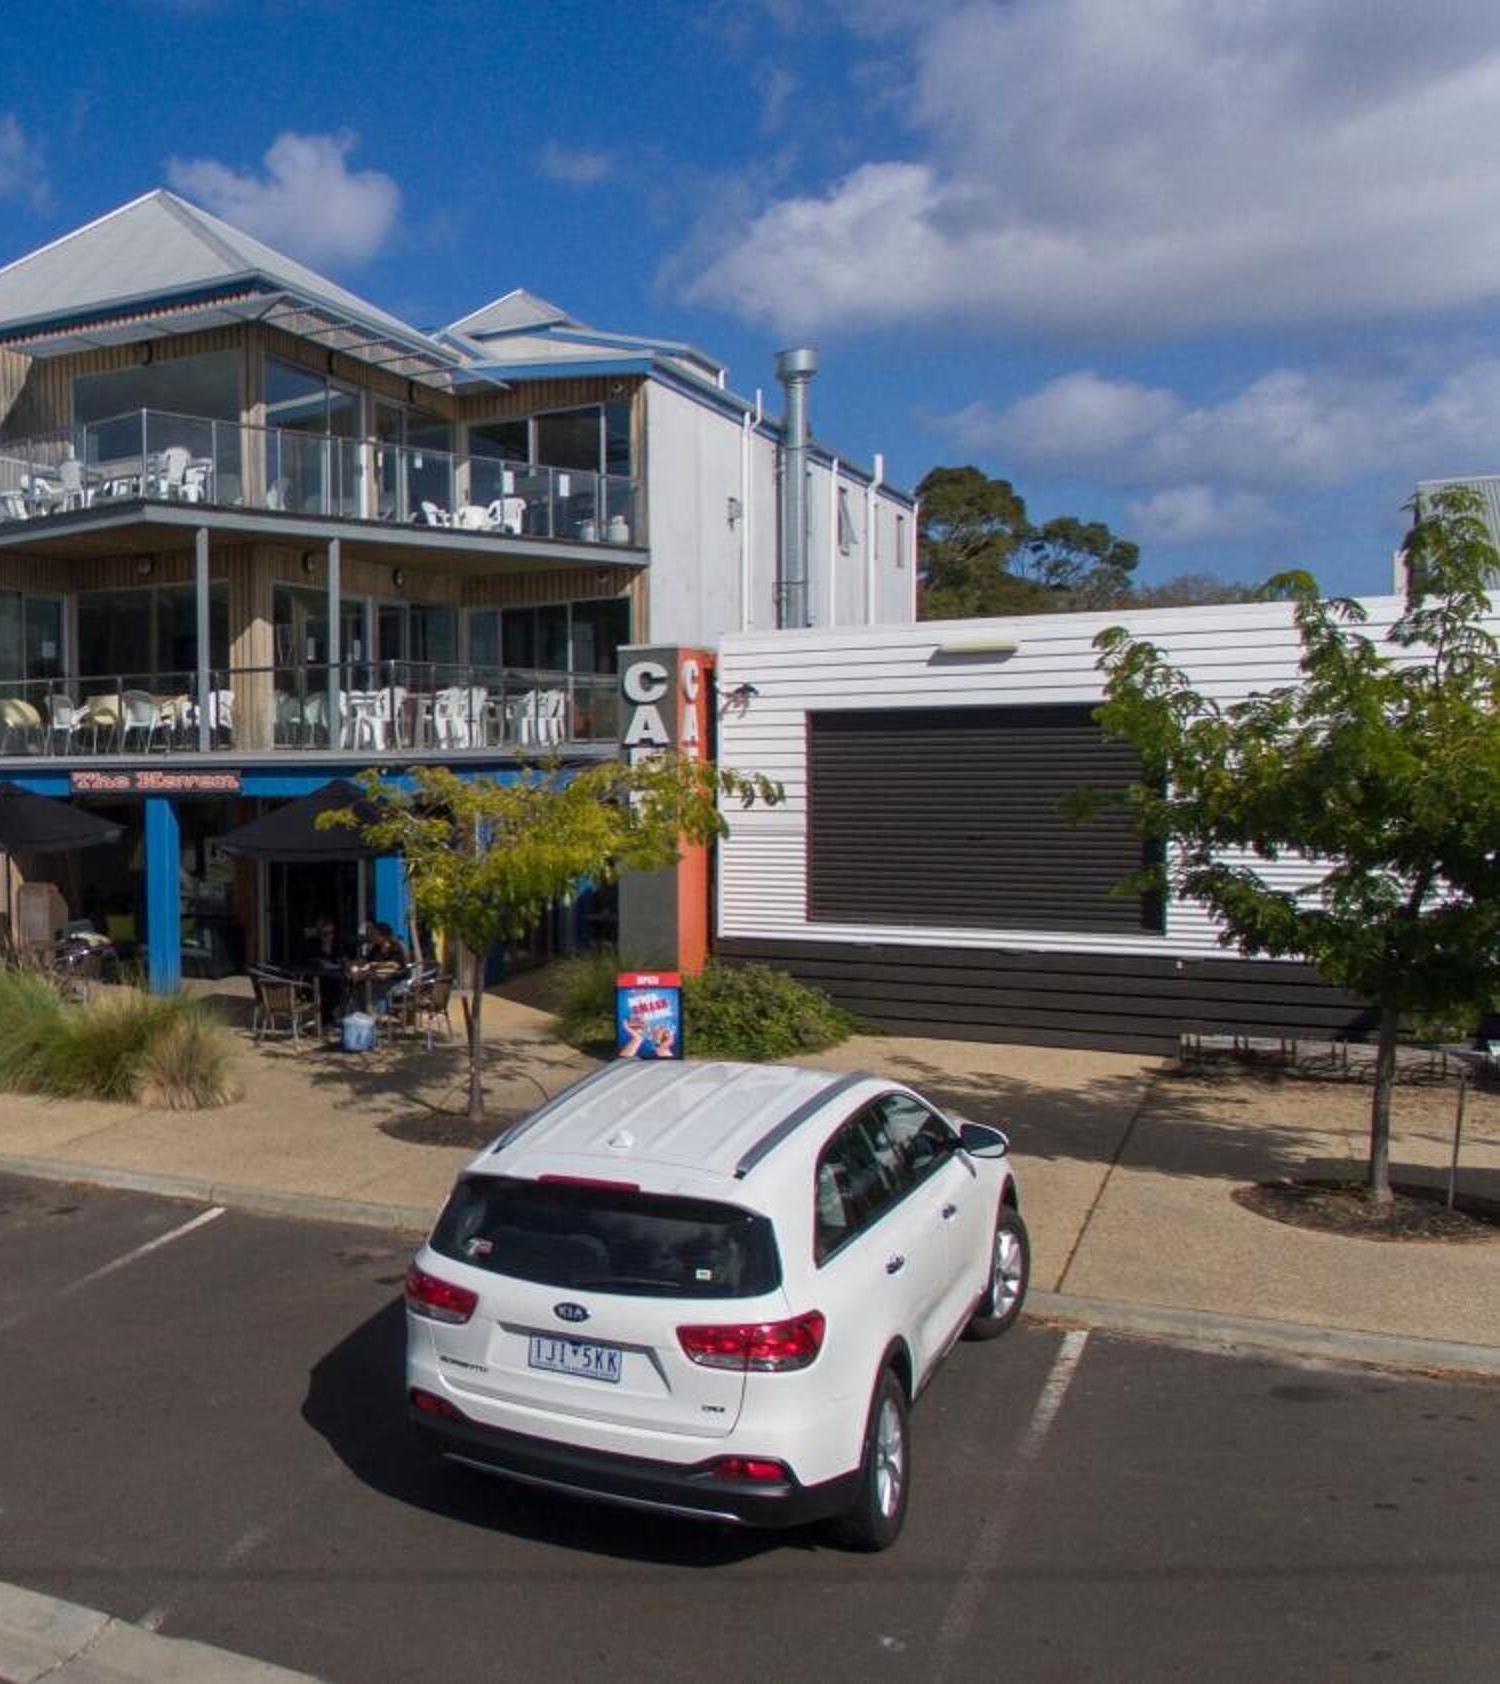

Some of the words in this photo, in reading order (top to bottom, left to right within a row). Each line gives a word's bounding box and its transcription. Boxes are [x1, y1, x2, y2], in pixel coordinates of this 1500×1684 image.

[623, 660, 671, 830] CA
[71, 771, 131, 789] The
[135, 771, 240, 789] Haven
[558, 1305, 585, 1321] KIA
